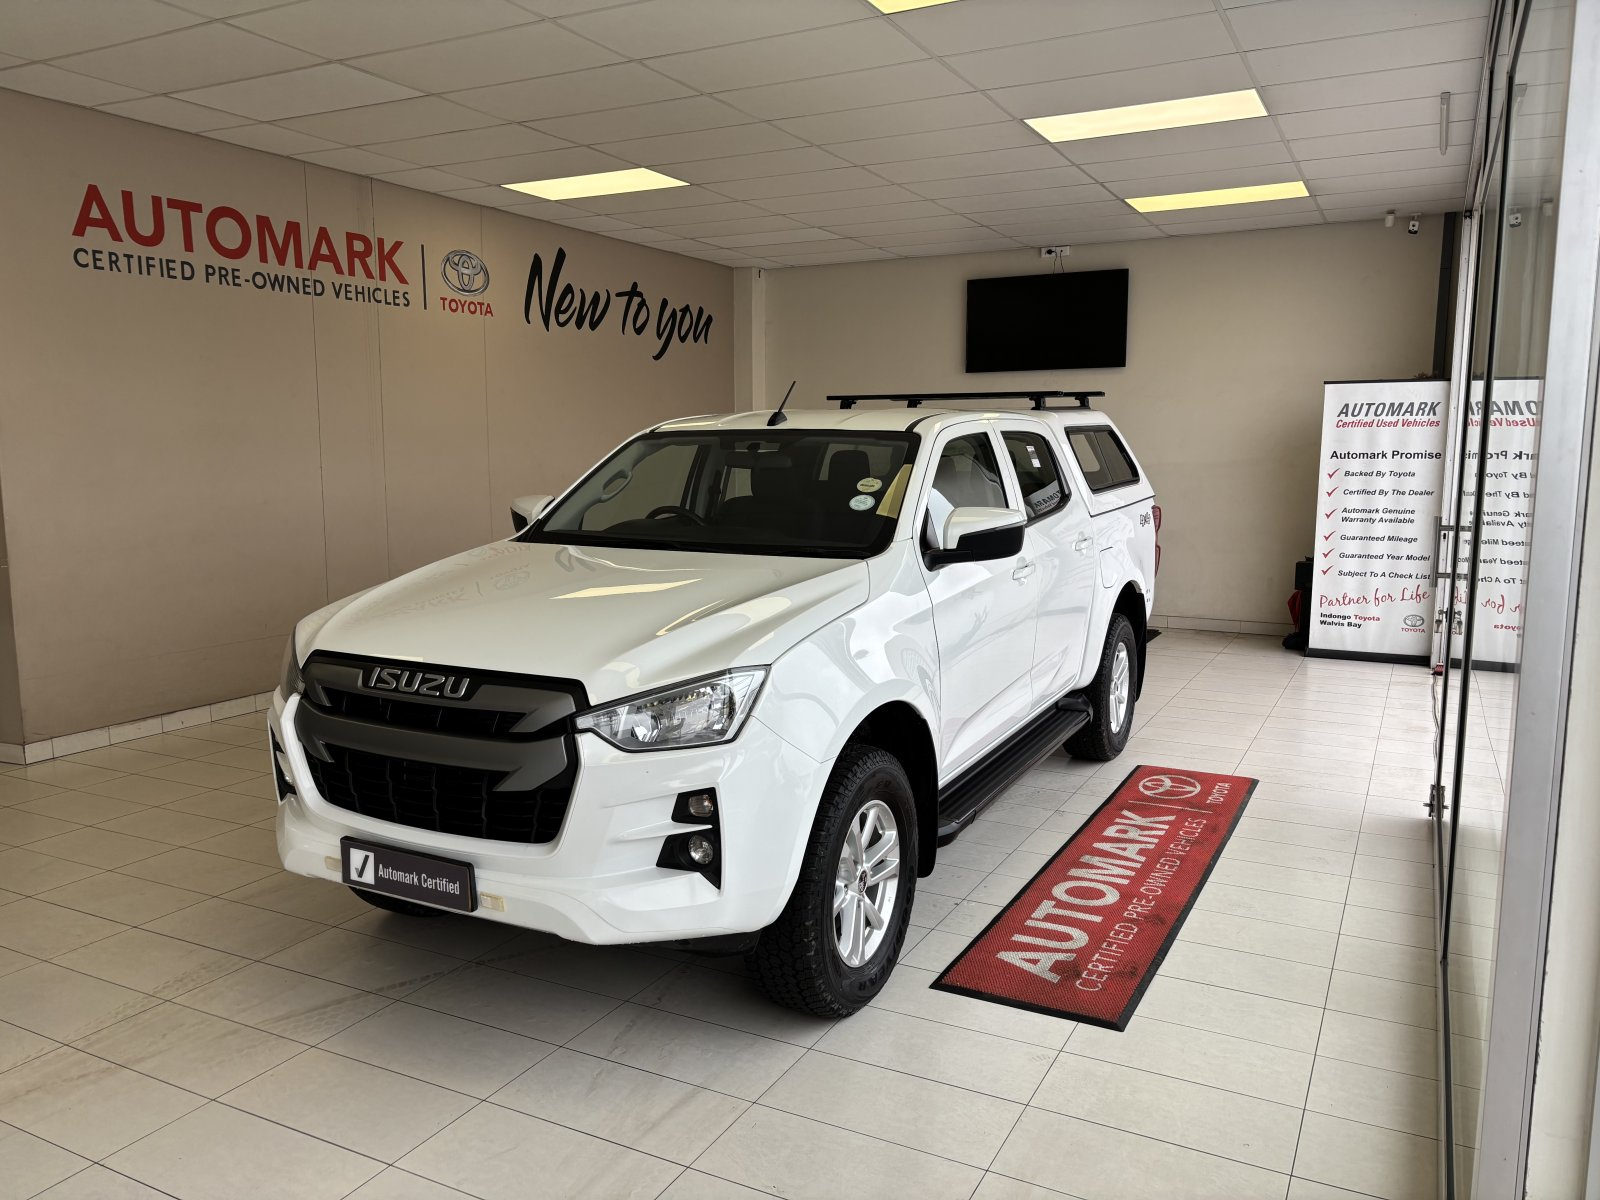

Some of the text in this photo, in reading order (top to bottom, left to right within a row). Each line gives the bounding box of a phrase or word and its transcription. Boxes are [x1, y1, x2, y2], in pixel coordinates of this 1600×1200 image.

[72, 184, 410, 285] AUTOMARK
[73, 247, 411, 307] CERTIFIED PRE-OWNED VEHICLES
[440, 296, 494, 317] TOYOTA
[525, 247, 713, 361] New to you
[1337, 402, 1441, 417] AUTOMARK
[1336, 418, 1440, 428] Certified Used Vehicles
[1330, 450, 1442, 460] Automark Promise
[1375, 470, 1387, 478] By
[1389, 470, 1416, 478] Toyota
[1343, 488, 1376, 496] Certified
[1378, 489, 1389, 497] By
[1408, 489, 1435, 497] Dealer
[1382, 507, 1416, 515] Genuine
[1341, 516, 1415, 524] Warranty Available
[1340, 534, 1418, 544] Guaranteed Mileage
[1339, 552, 1431, 562] Guaranteed Year Model
[1338, 570, 1367, 578] Subject
[1388, 571, 1413, 579] Check
[1415, 572, 1431, 580] List
[1319, 584, 1430, 608] Partner for Life
[1320, 612, 1381, 623] Indongo Toyota
[1319, 620, 1362, 629] Walvis Bay
[368, 667, 470, 699] ISUZU
[1206, 782, 1232, 805] TOYOTA
[378, 863, 460, 895] Automark Certified
[995, 809, 1177, 984] AUTOMARK
[1076, 817, 1207, 991] CERTIFIED PRE-OWNED VEHICLES
